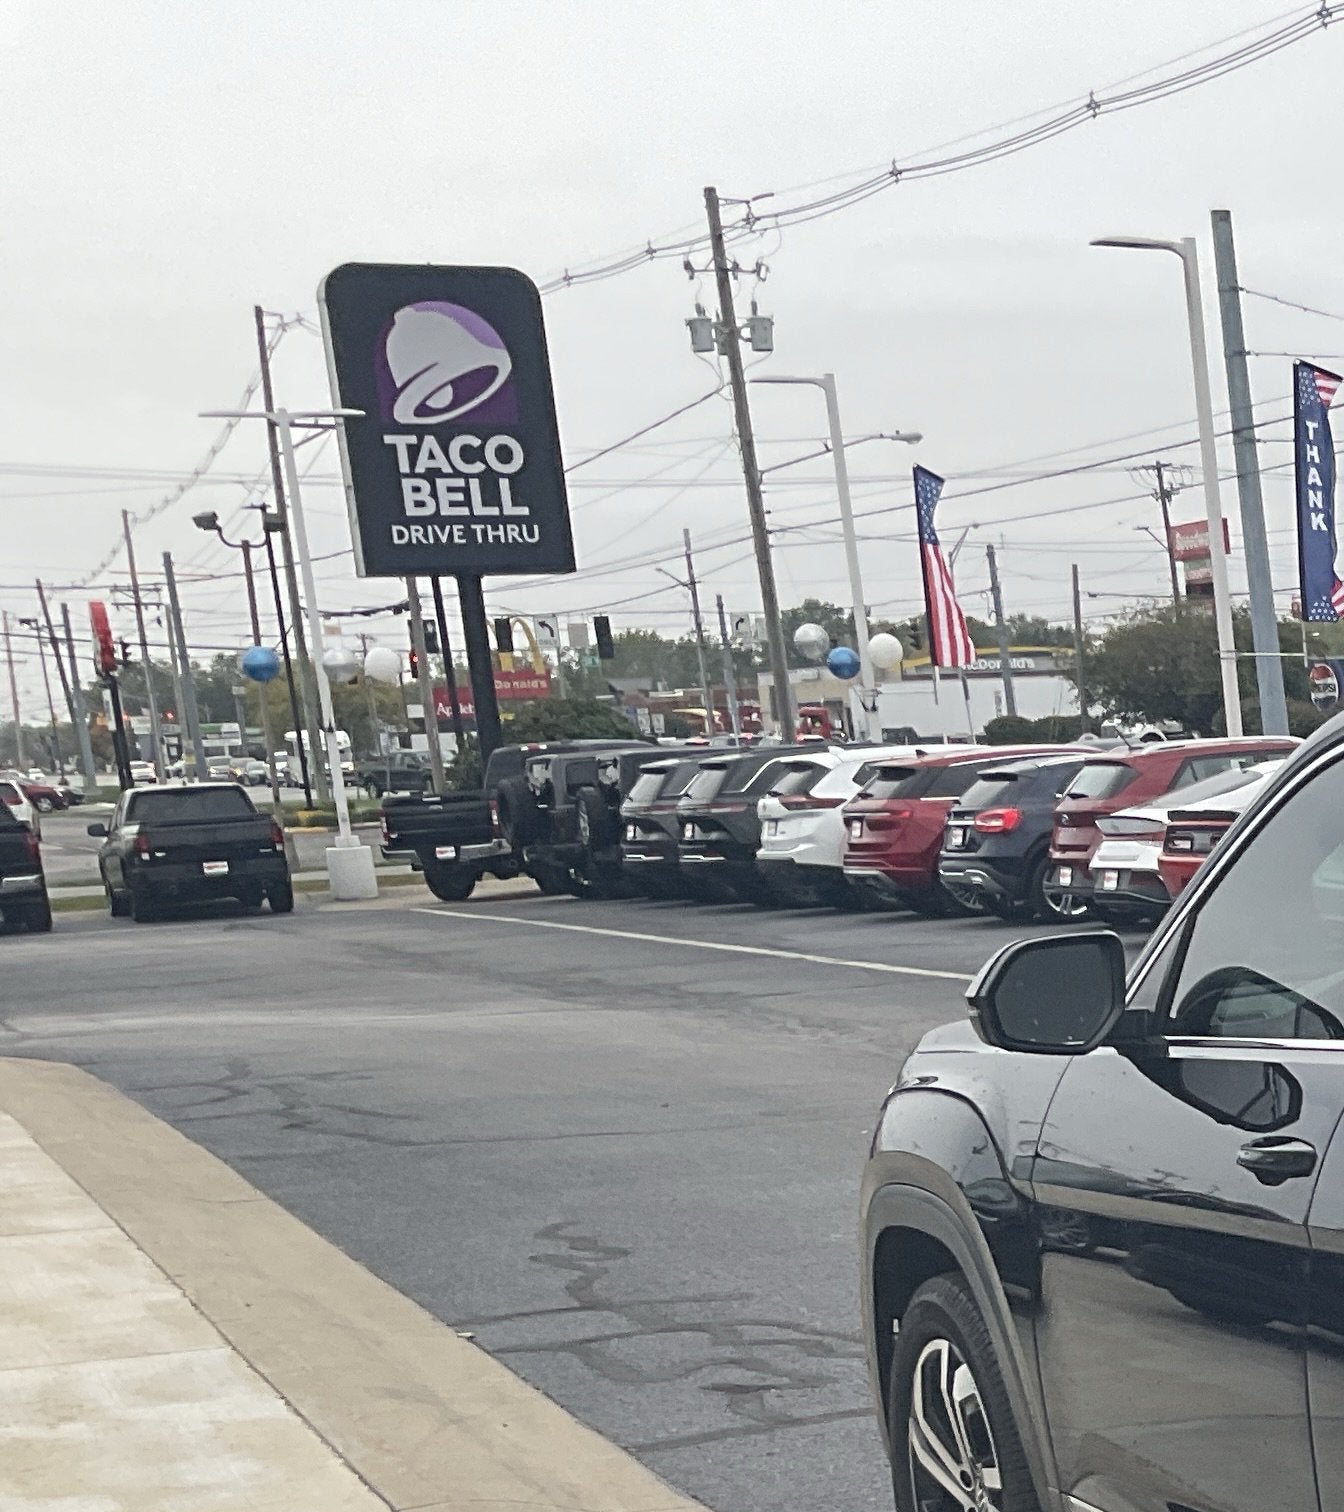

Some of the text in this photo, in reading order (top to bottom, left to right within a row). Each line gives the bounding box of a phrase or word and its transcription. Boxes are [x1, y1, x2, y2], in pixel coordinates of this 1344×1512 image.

[383, 434, 525, 474] TACO
[1304, 419, 1329, 532] THANK
[401, 477, 530, 517] BELL
[391, 523, 541, 545] DRIVE THRU
